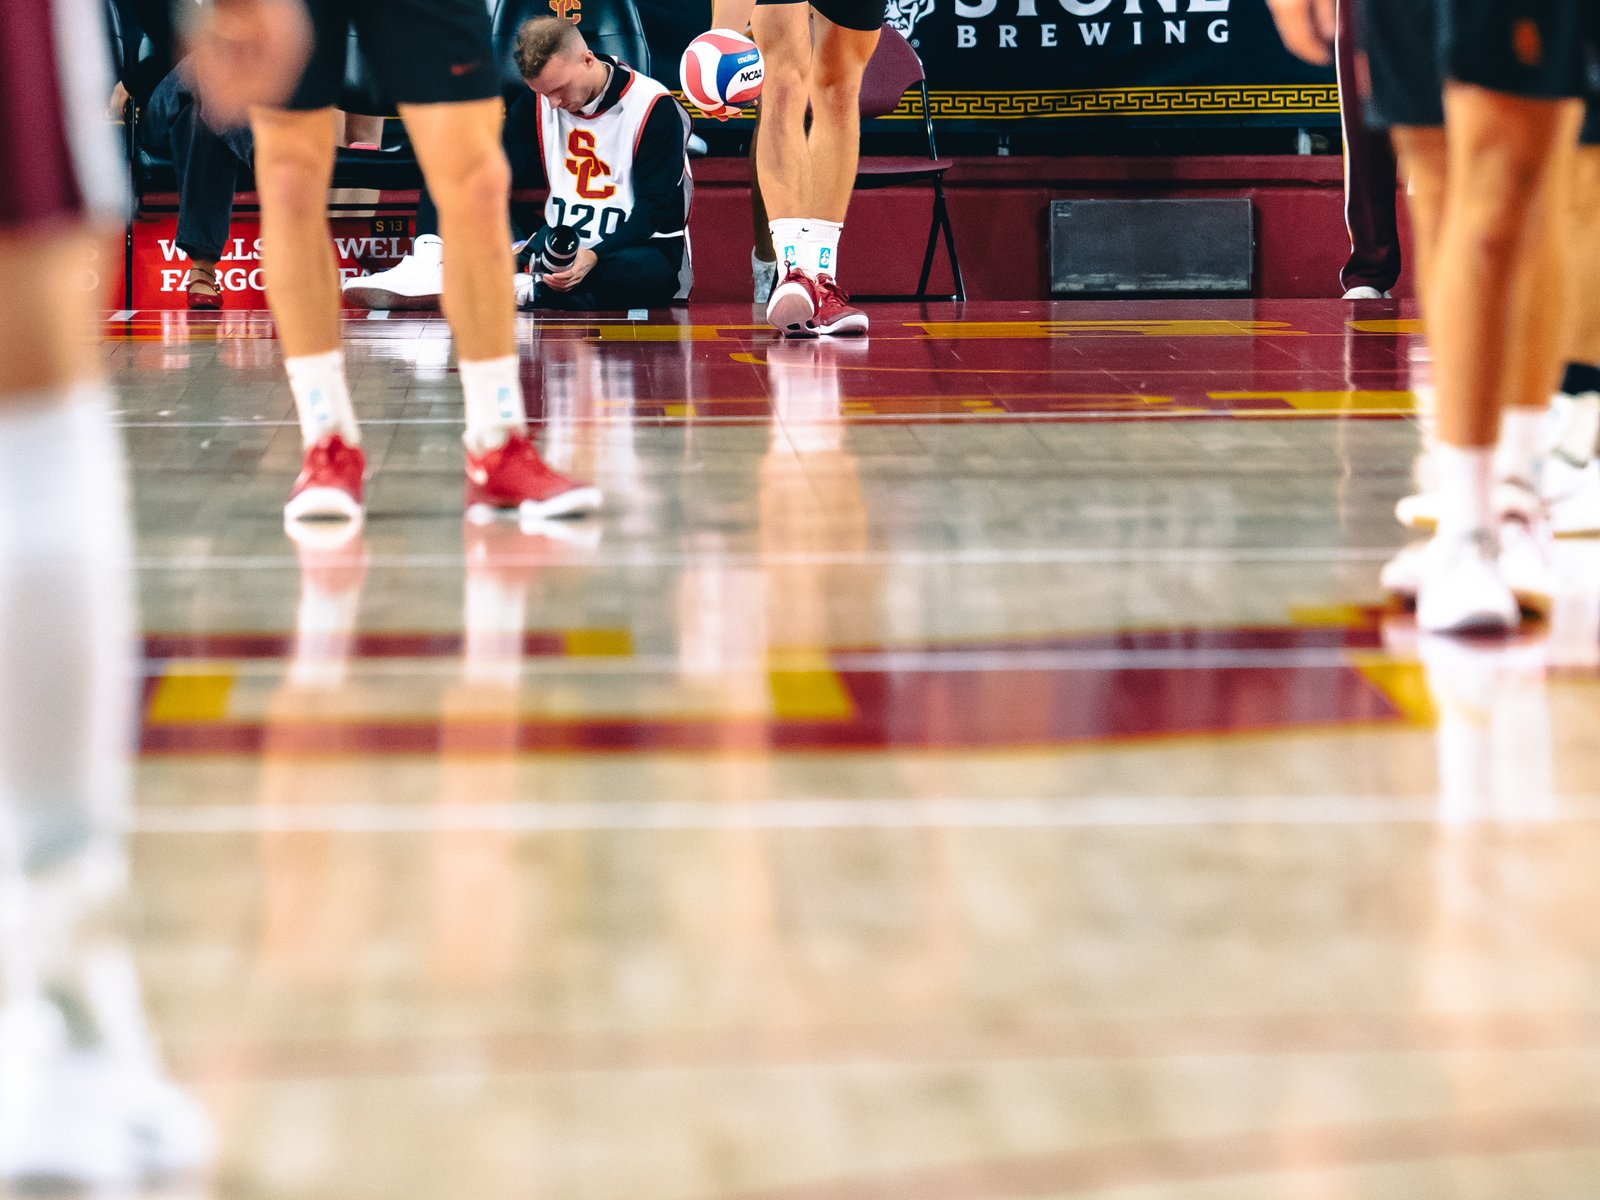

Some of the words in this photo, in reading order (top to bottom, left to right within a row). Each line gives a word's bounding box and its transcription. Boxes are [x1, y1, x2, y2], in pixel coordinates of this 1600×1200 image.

[956, 19, 1230, 49] BREWING
[564, 128, 616, 200] SC
[157, 238, 265, 261] WLS
